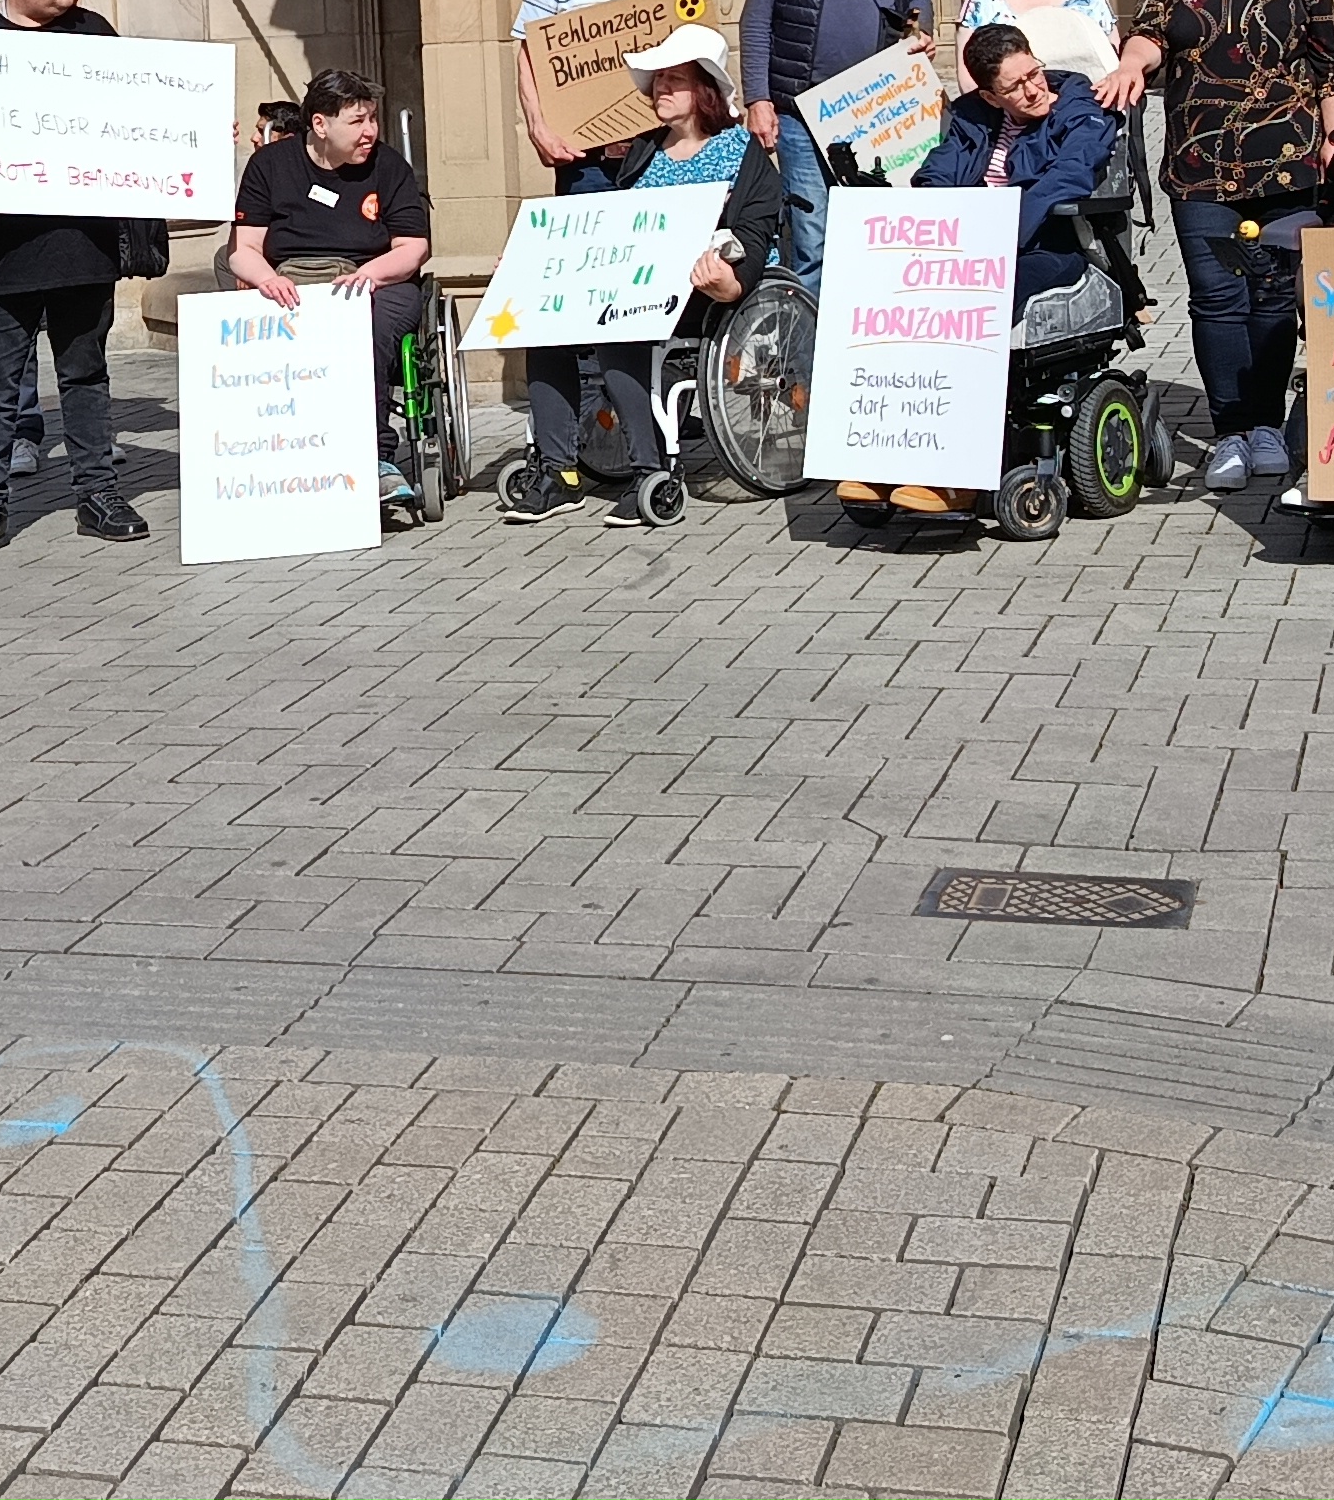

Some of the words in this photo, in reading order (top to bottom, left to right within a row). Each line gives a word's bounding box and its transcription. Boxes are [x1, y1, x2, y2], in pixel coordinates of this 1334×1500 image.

[539, 3, 668, 52] Fehlanzeige
[82, 63, 152, 86] BEHANDELT
[155, 72, 214, 93] WERDEN
[851, 93, 875, 120] nur
[873, 96, 920, 127] Tickets
[32, 111, 90, 136] JEDER
[100, 122, 159, 142] ANDERE
[162, 129, 199, 149] AUCH
[870, 126, 893, 148] nur
[894, 112, 917, 140] per
[632, 210, 666, 233] MIR
[864, 215, 959, 246] TÜREN
[543, 257, 565, 279] ES
[575, 244, 637, 273] SELBST
[902, 252, 1006, 290] ÖFFNEN
[538, 294, 564, 312] ZU
[220, 311, 300, 347] MEHR
[851, 305, 1001, 342] HORIZONTE
[850, 367, 953, 391] Brandschutz
[257, 397, 296, 418] und
[849, 394, 889, 422] darf
[901, 396, 951, 417] nicht
[214, 429, 329, 457] bezahlbarer
[846, 422, 946, 452] behindern.
[216, 472, 356, 500] Wohnraum
